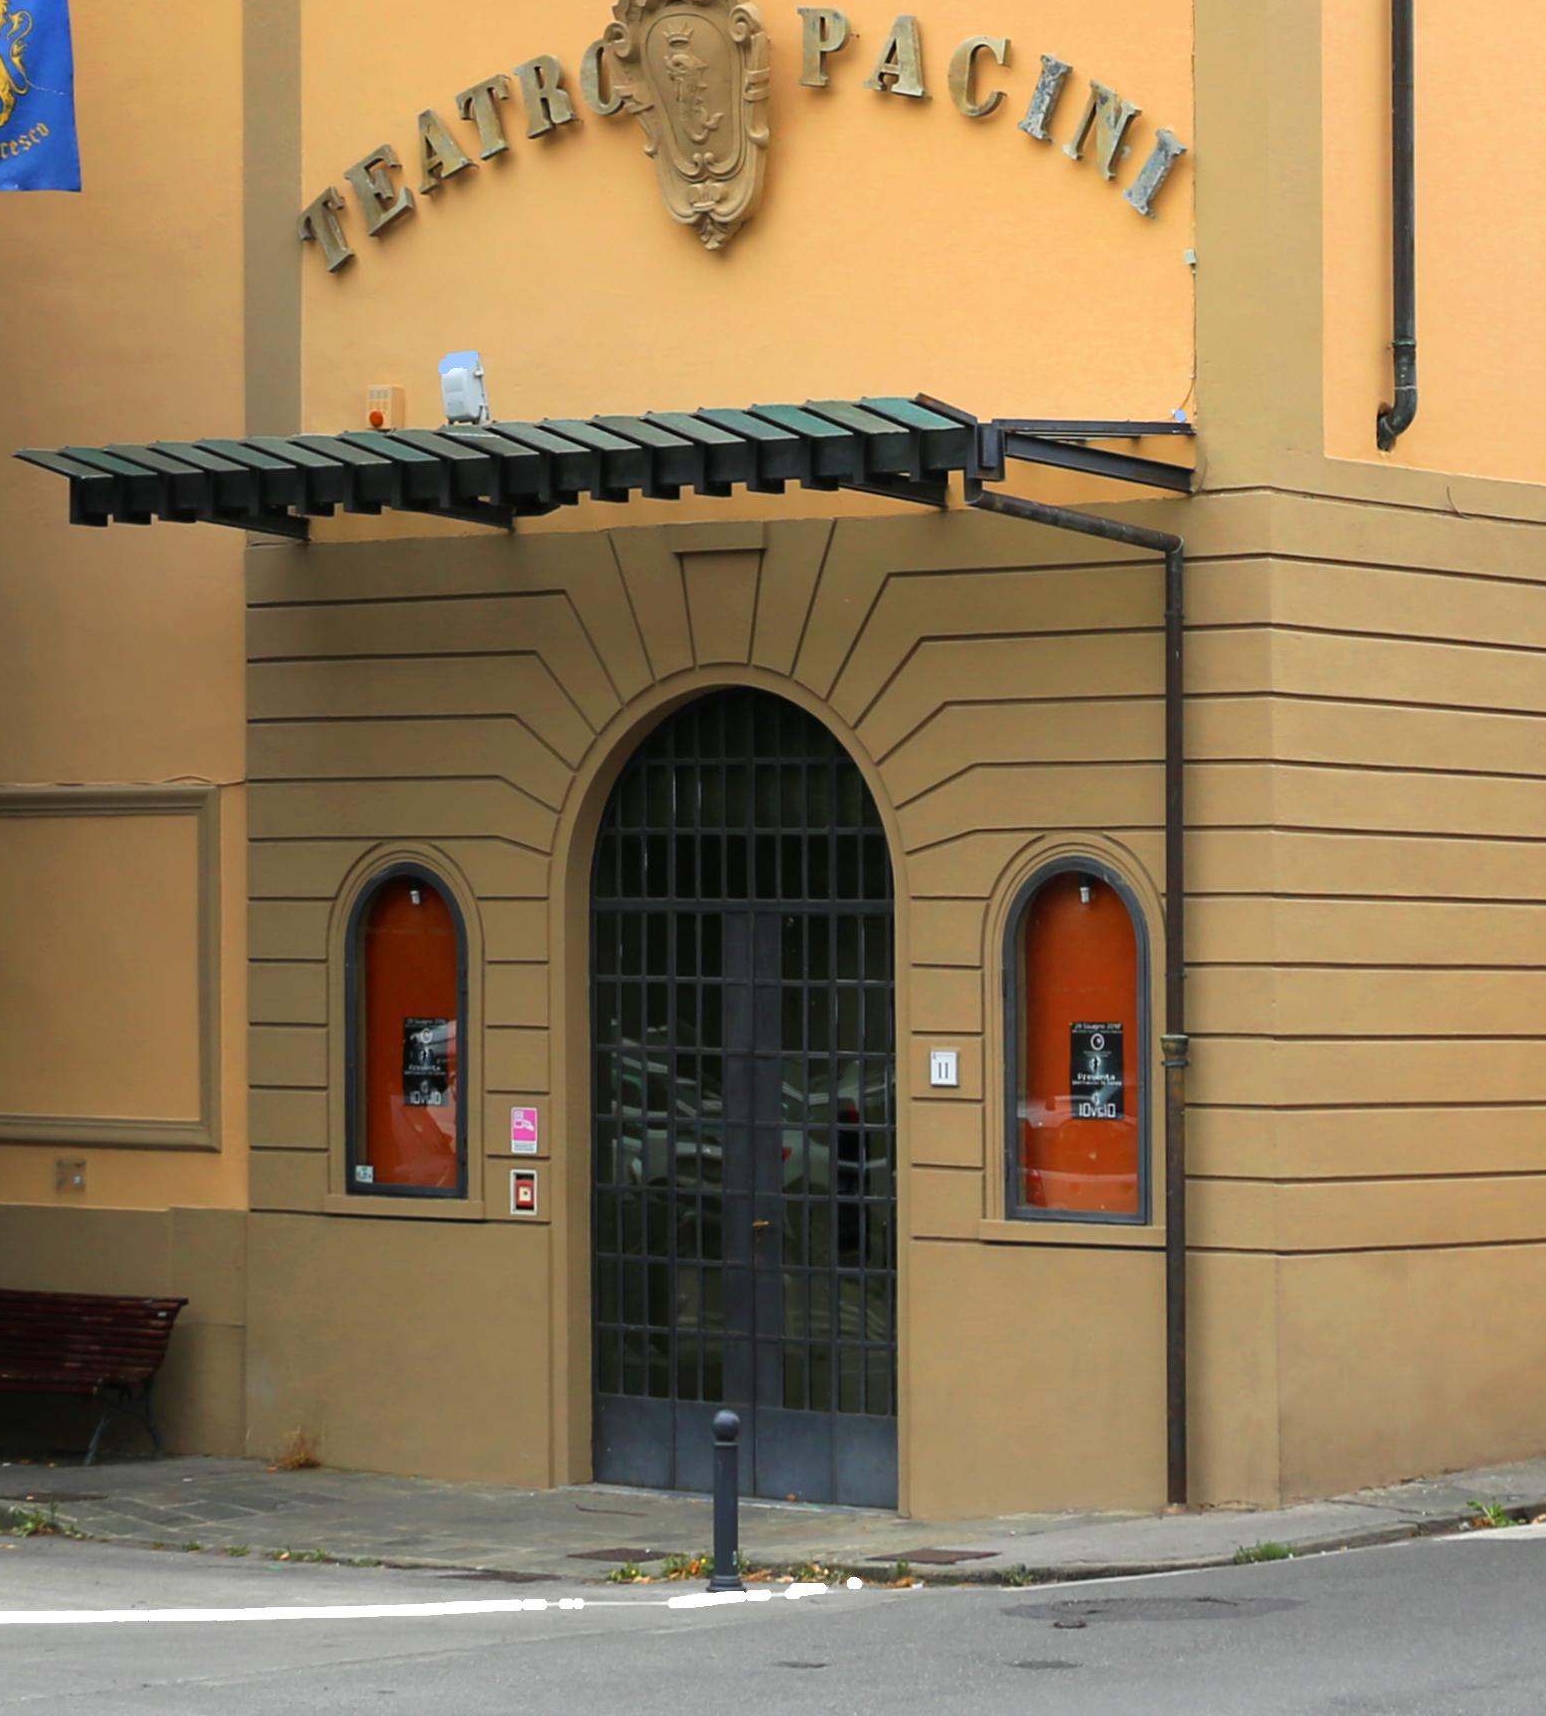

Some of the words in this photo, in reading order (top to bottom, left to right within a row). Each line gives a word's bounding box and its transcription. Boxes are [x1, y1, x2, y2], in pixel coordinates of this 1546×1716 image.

[297, 38, 627, 274] TEATRO
[796, 5, 1188, 219] PACINI
[938, 1061, 949, 1079] 11
